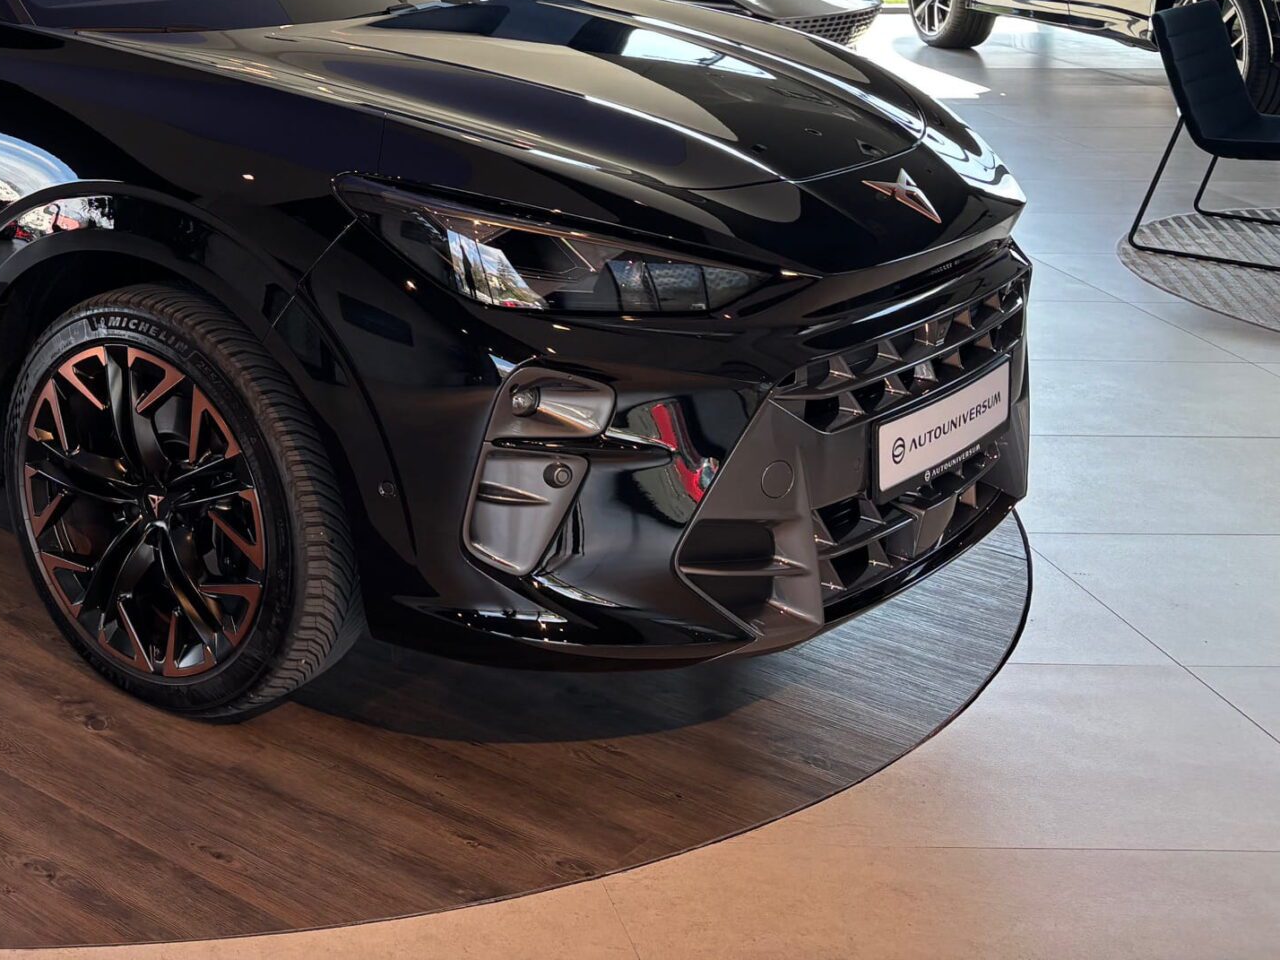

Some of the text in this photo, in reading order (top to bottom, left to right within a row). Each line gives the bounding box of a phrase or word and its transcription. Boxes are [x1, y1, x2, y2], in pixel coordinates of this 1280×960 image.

[107, 315, 189, 353] MICHELIN
[908, 391, 1001, 452] AUTOUNIVERSUM
[931, 443, 981, 477] AUTOUNIVERSUM
